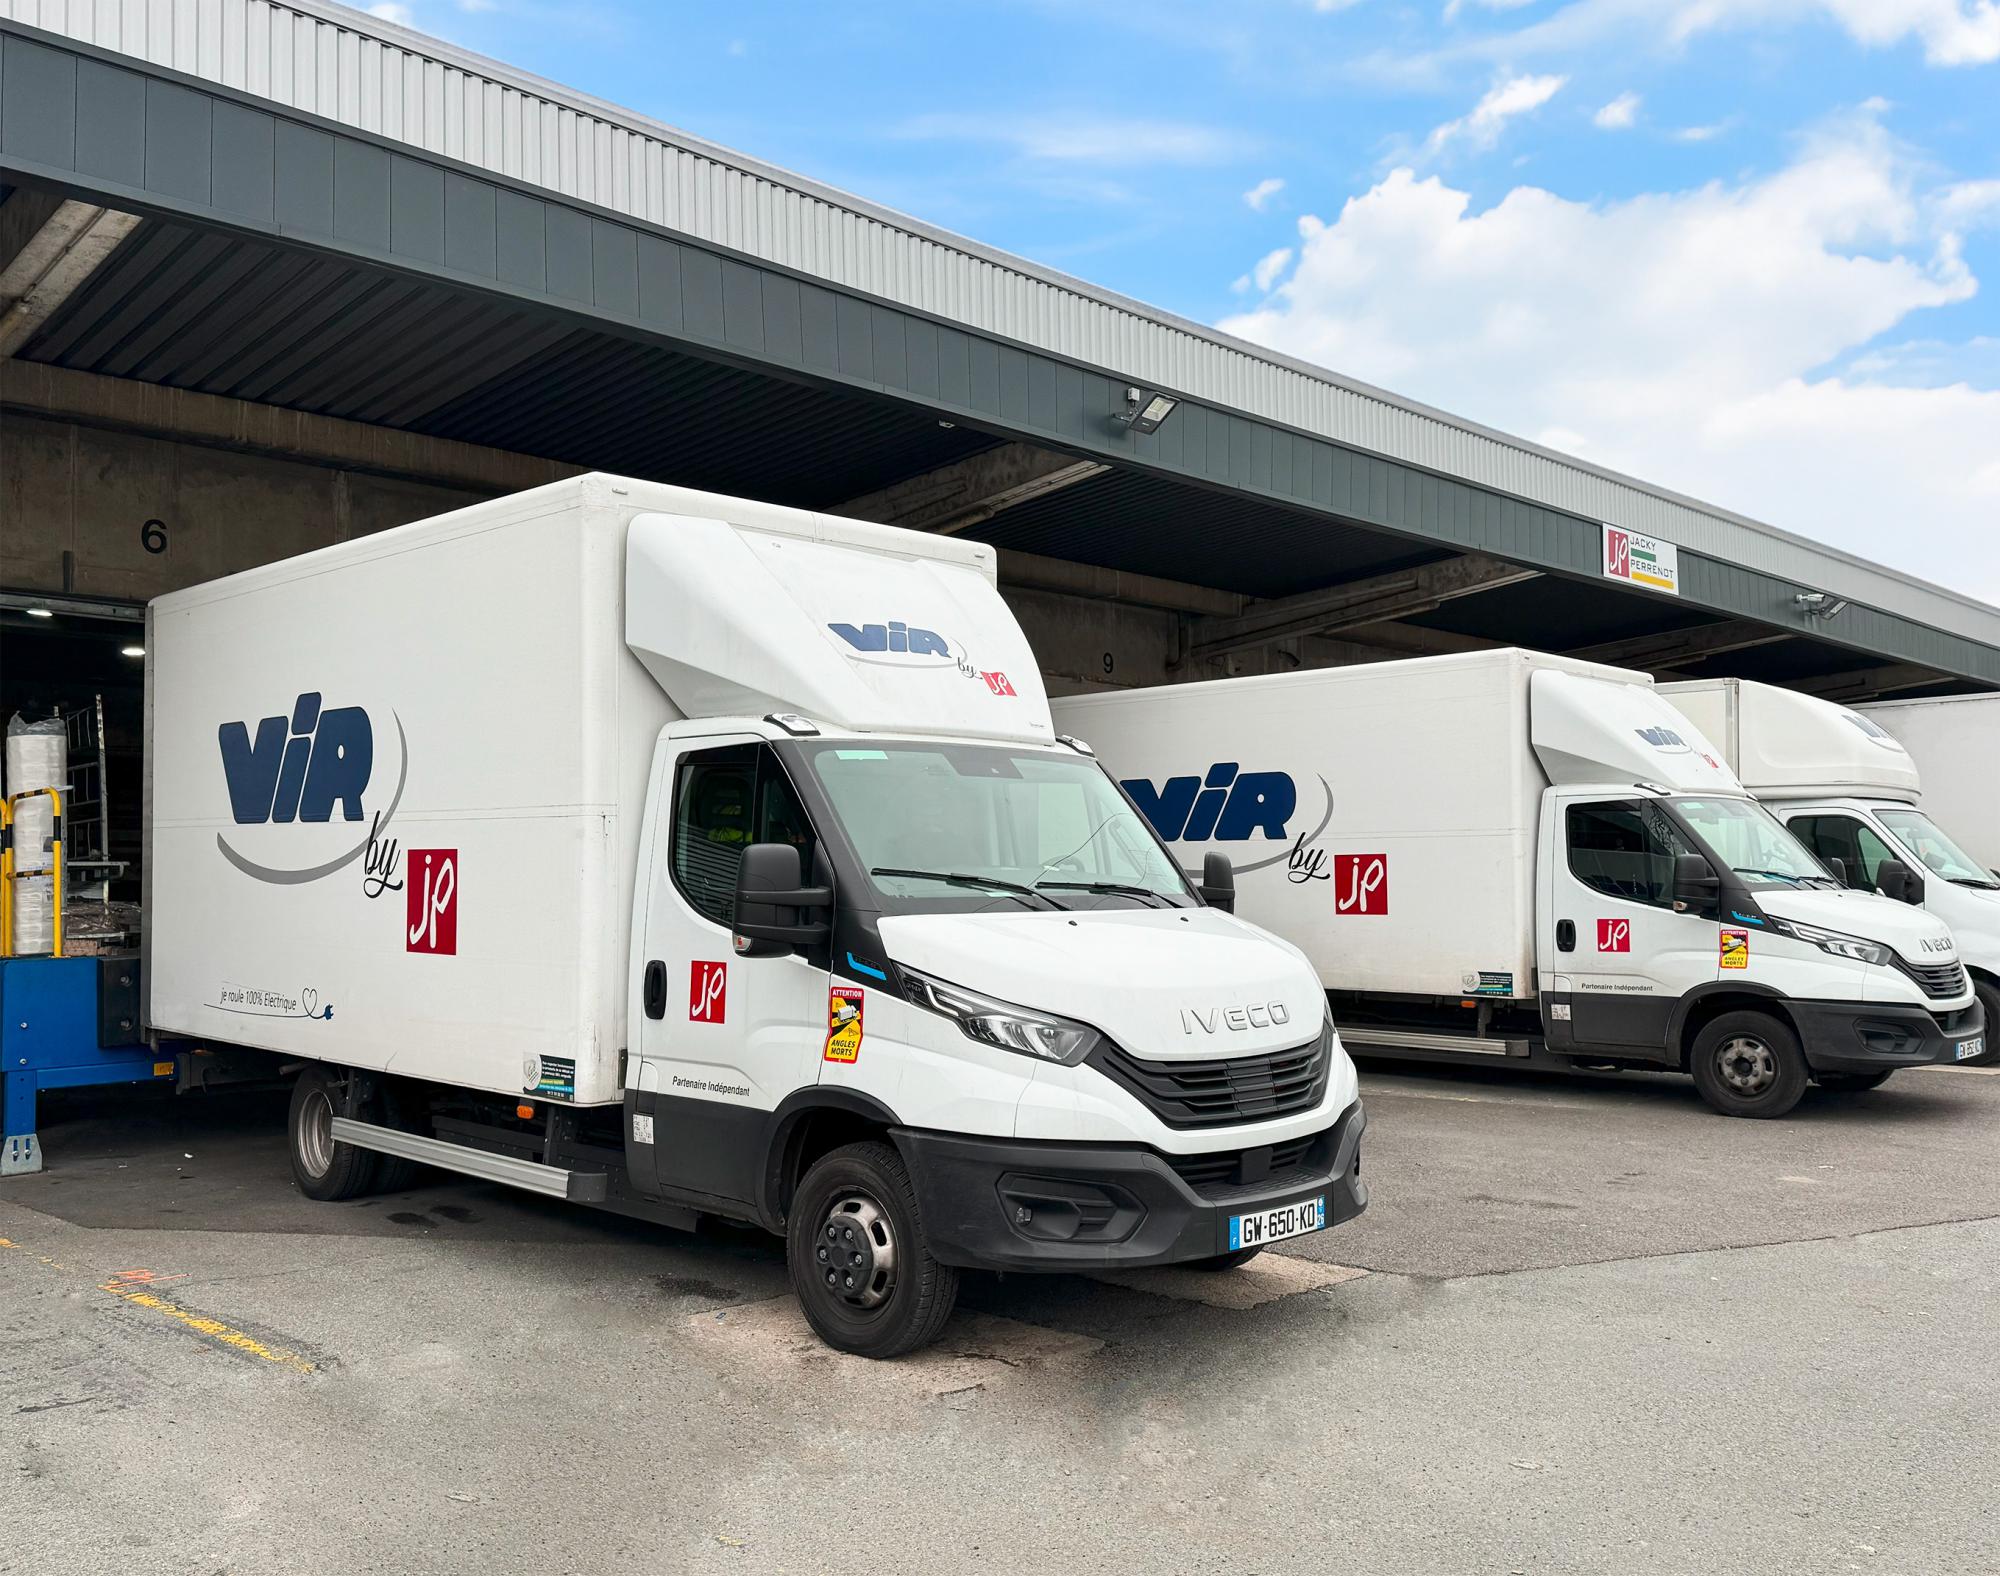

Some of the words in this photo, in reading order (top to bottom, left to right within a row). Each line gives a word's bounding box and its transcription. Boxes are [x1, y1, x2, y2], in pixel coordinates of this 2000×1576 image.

[141, 519, 167, 554] 6
[1630, 537, 1656, 551] JACKY
[1630, 559, 1674, 579] PERRENOT
[1103, 652, 1114, 674] 9
[363, 810, 404, 899] by
[1287, 832, 1331, 884] by
[1919, 937, 1953, 952] IVECO
[220, 986, 227, 1004] je
[228, 988, 244, 1003] roule
[246, 990, 262, 1006] 100%
[832, 990, 863, 998] ATTENTION
[1179, 1000, 1291, 1034] IVECO
[830, 1039, 856, 1049] ANGLES
[830, 1047, 853, 1057] MORTS
[672, 1075, 707, 1091] Partenaire
[708, 1081, 750, 1097] Indépendant
[1317, 1213, 1325, 1226] 26
